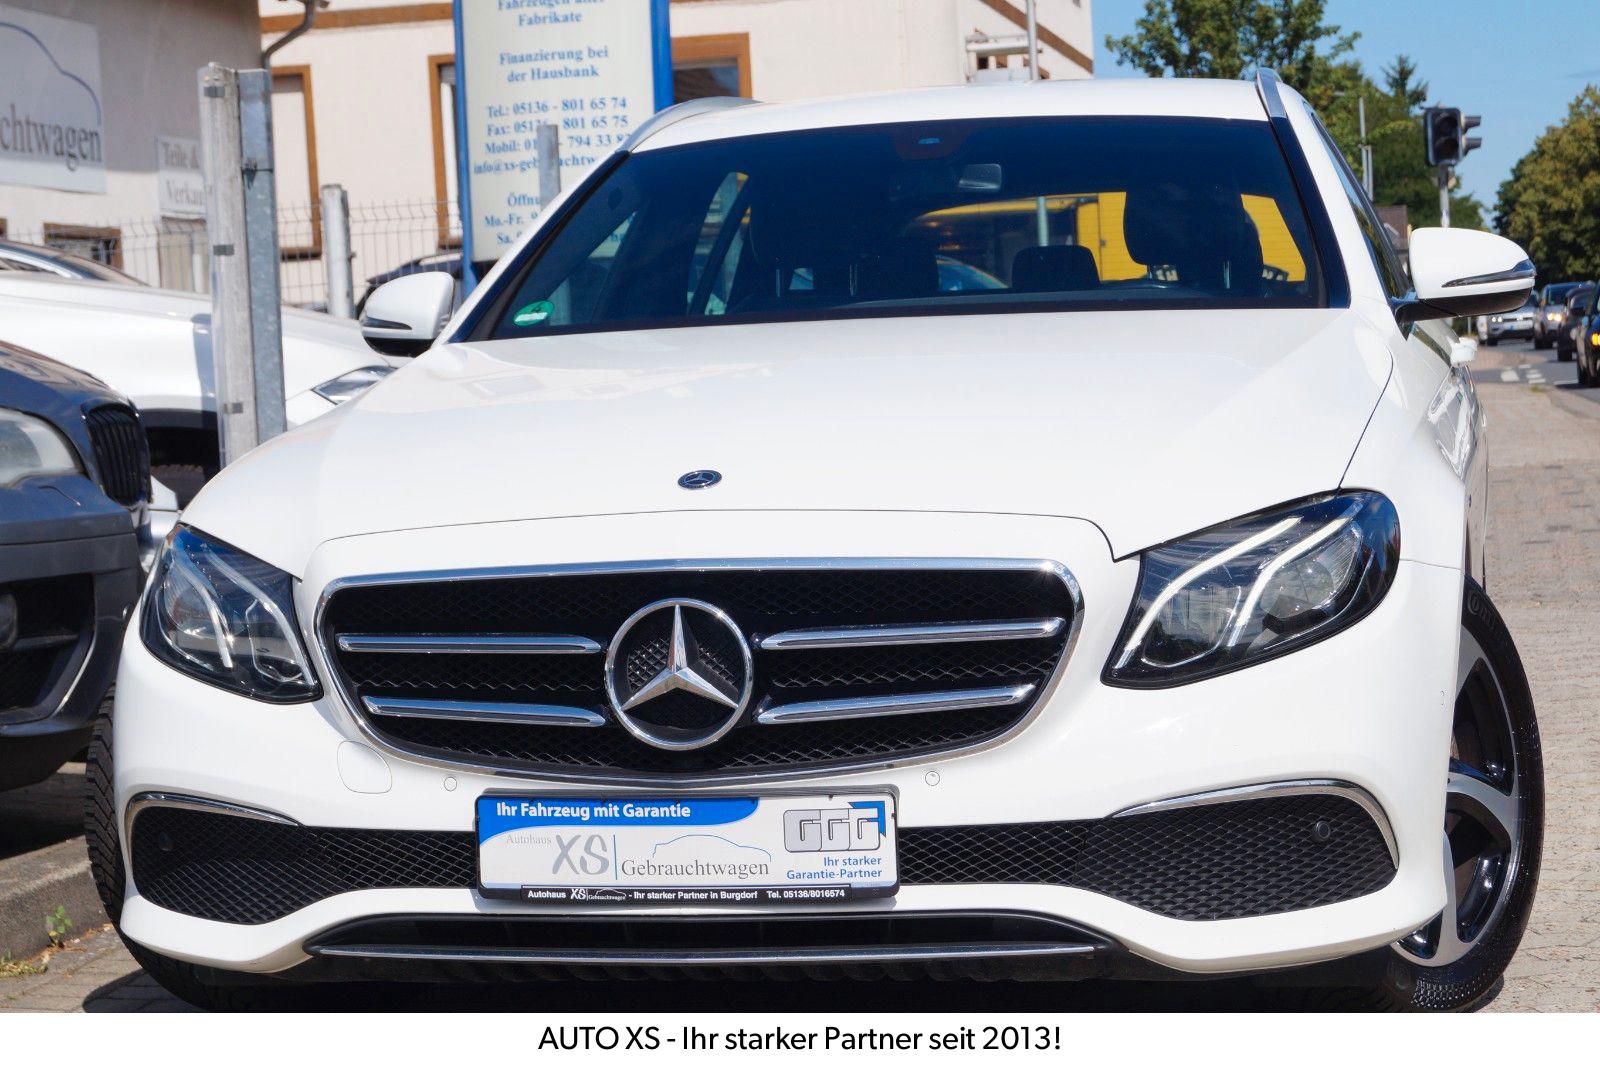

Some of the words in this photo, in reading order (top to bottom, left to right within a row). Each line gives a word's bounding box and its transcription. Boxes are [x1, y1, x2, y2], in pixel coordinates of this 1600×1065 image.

[518, 11, 582, 26] Fabrikate
[499, 48, 583, 65] Finanzierung
[587, 46, 609, 59] bei
[507, 69, 527, 82] der
[531, 65, 600, 80] Hausbank
[513, 101, 549, 115] 05136
[561, 99, 585, 111] 801
[590, 97, 606, 109] 65
[611, 97, 627, 109] 74
[487, 123, 510, 136] Fax:
[563, 117, 586, 129] 801
[591, 116, 608, 128] 65
[612, 114, 629, 127] 75
[485, 140, 521, 153] Mobil:
[567, 134, 591, 147] 794
[596, 133, 612, 147] 33
[497, 802, 516, 817] Ihr
[521, 803, 590, 820] Fahrzeug
[594, 803, 620, 818] mit
[623, 802, 691, 818] Garantie
[506, 834, 552, 845] Autohaus
[552, 834, 610, 875] XS
[823, 857, 839, 866] Ihr
[842, 856, 882, 866] starker
[622, 859, 769, 879] Gebrauchtwagen
[787, 869, 882, 880] Garantie-Partner
[527, 890, 567, 899] Autohaus
[570, 888, 586, 900] XS
[634, 891, 646, 899] Ihr
[647, 891, 676, 899] starker
[677, 890, 708, 899] Partner
[710, 890, 718, 899] in
[720, 890, 758, 901] Burgdorf
[766, 890, 782, 899] Tel.
[783, 890, 845, 899] 05136/8016574
